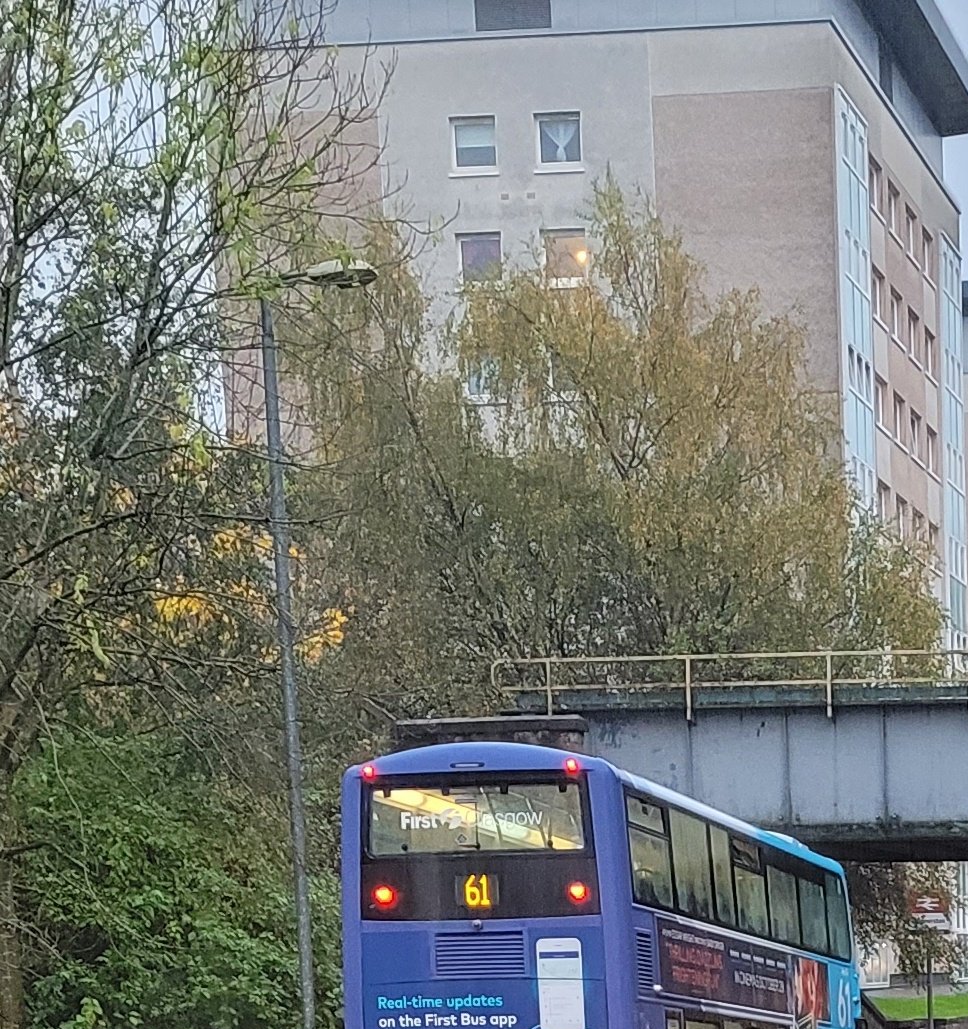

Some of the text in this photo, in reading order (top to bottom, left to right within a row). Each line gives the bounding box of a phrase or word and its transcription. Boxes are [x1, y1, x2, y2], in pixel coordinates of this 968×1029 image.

[400, 810, 543, 830] First Glasgow
[464, 873, 492, 909] 61
[377, 994, 503, 1010] Real-time updates
[837, 978, 851, 1028] 61
[379, 1013, 517, 1028] on the First Bus app
